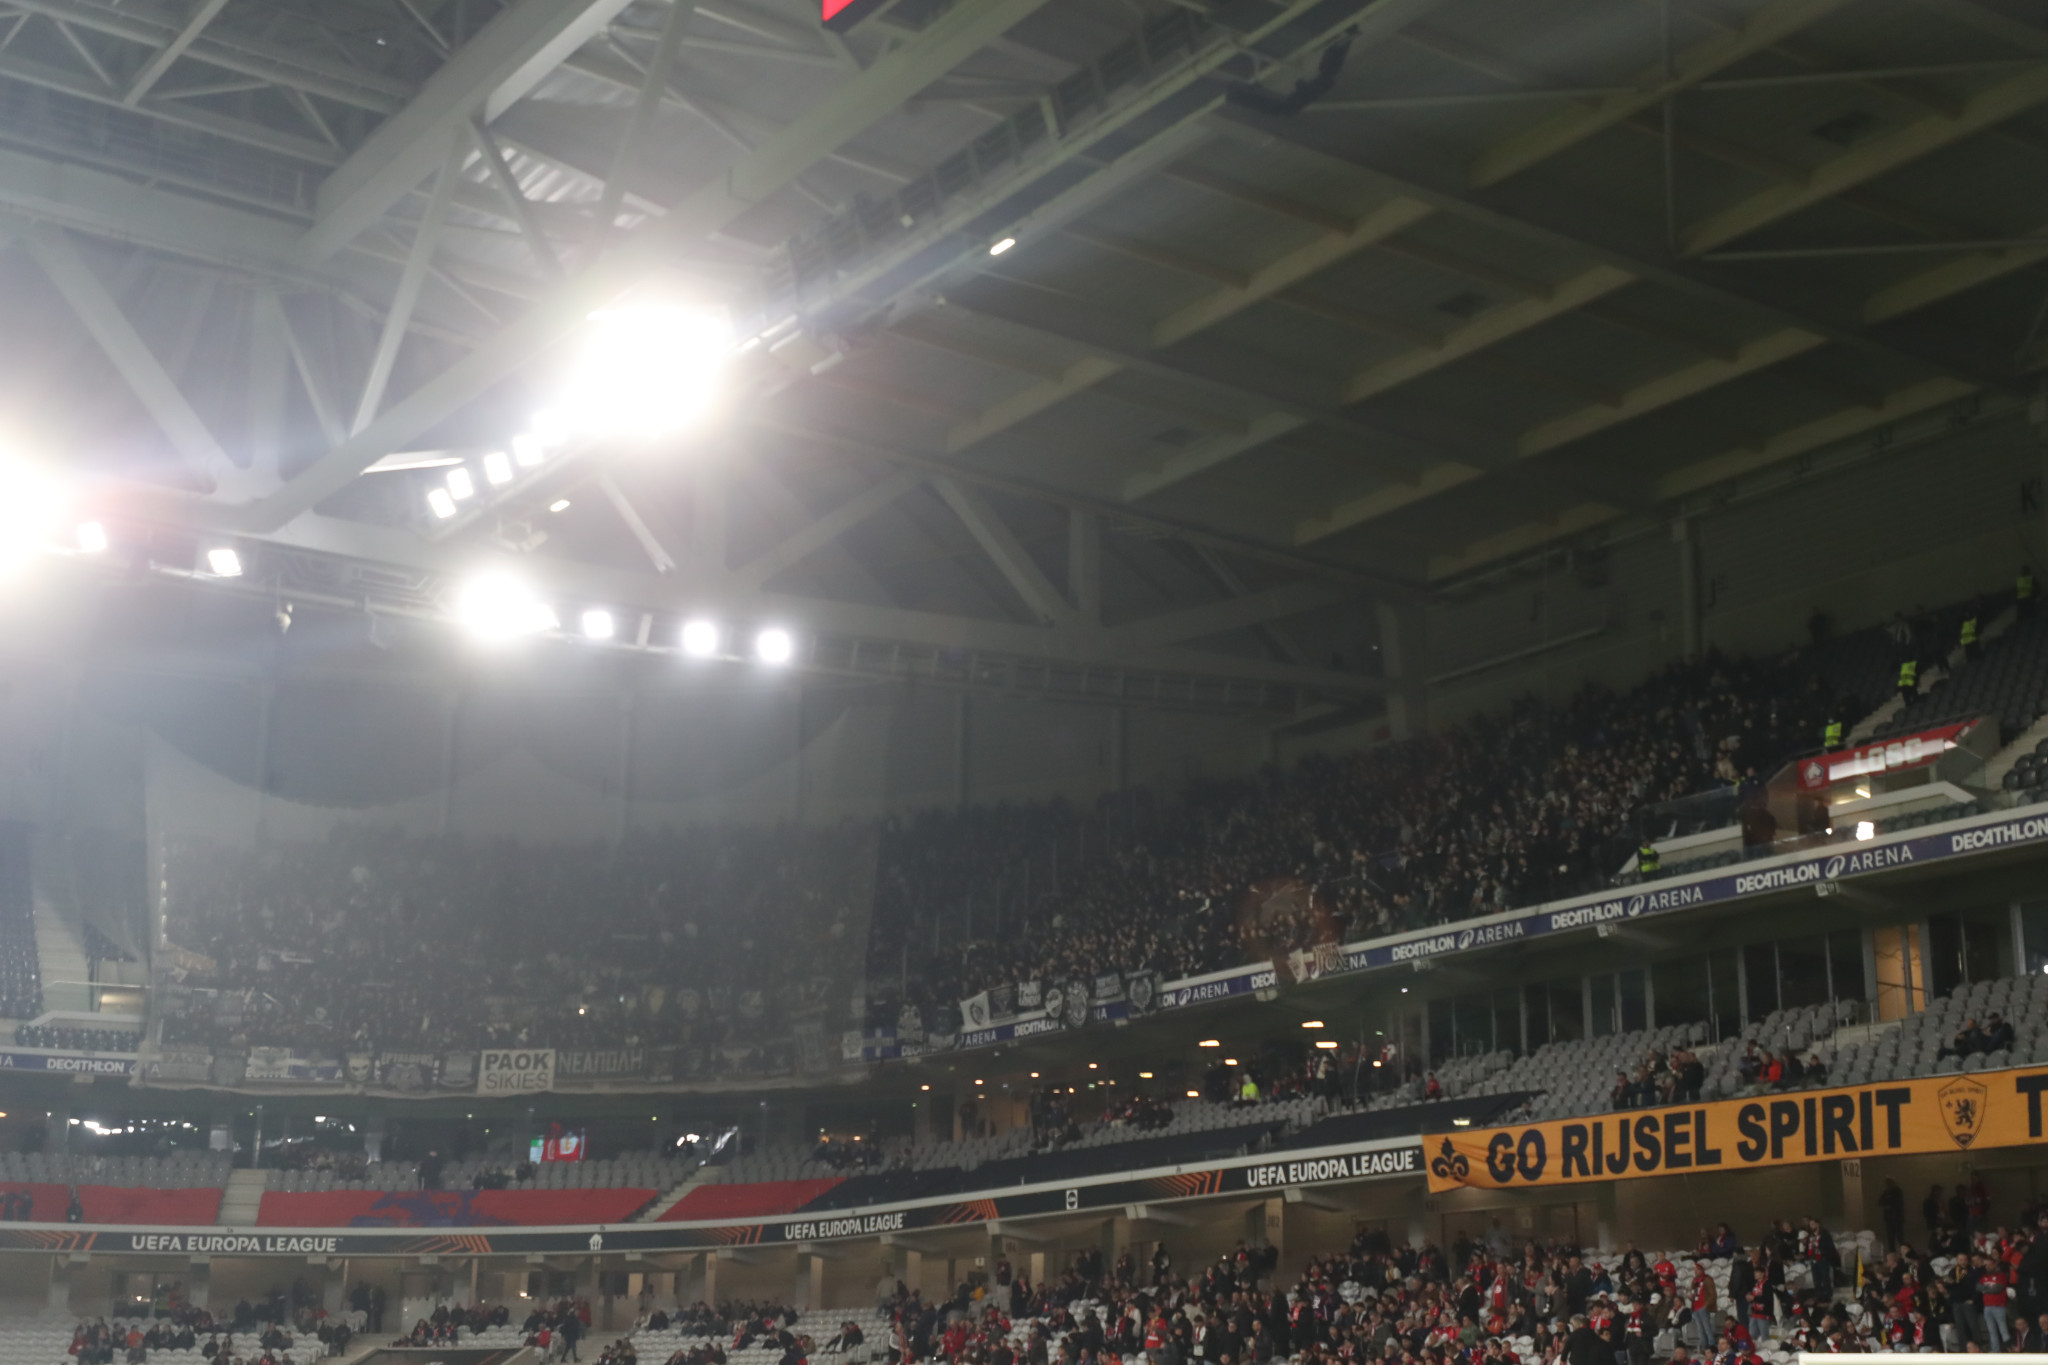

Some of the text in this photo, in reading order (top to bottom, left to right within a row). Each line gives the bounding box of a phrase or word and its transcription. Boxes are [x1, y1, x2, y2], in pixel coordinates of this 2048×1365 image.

[1951, 819, 2048, 853] DECATHLON
[1736, 862, 1820, 895] DECATHLON
[1849, 844, 1913, 873] ARENA
[1551, 886, 1704, 930] DECATHLON ARENA
[1392, 921, 1525, 960] DECATHLON ARENA
[1193, 982, 1230, 1001] ARENA
[965, 1029, 997, 1046] ARENA
[47, 1058, 124, 1073] DECATHLON
[485, 1053, 550, 1070] PAOK
[485, 1072, 548, 1090] SIKIES
[1487, 1087, 1911, 1183] GO RIJSEL SPIRIT
[1247, 1150, 1414, 1187] UEFA EUROPA LEAGUE
[785, 1213, 903, 1240] UEFA EUROPA LEAGUE
[131, 1235, 337, 1252] UEFA EUROPA LEAGUE
